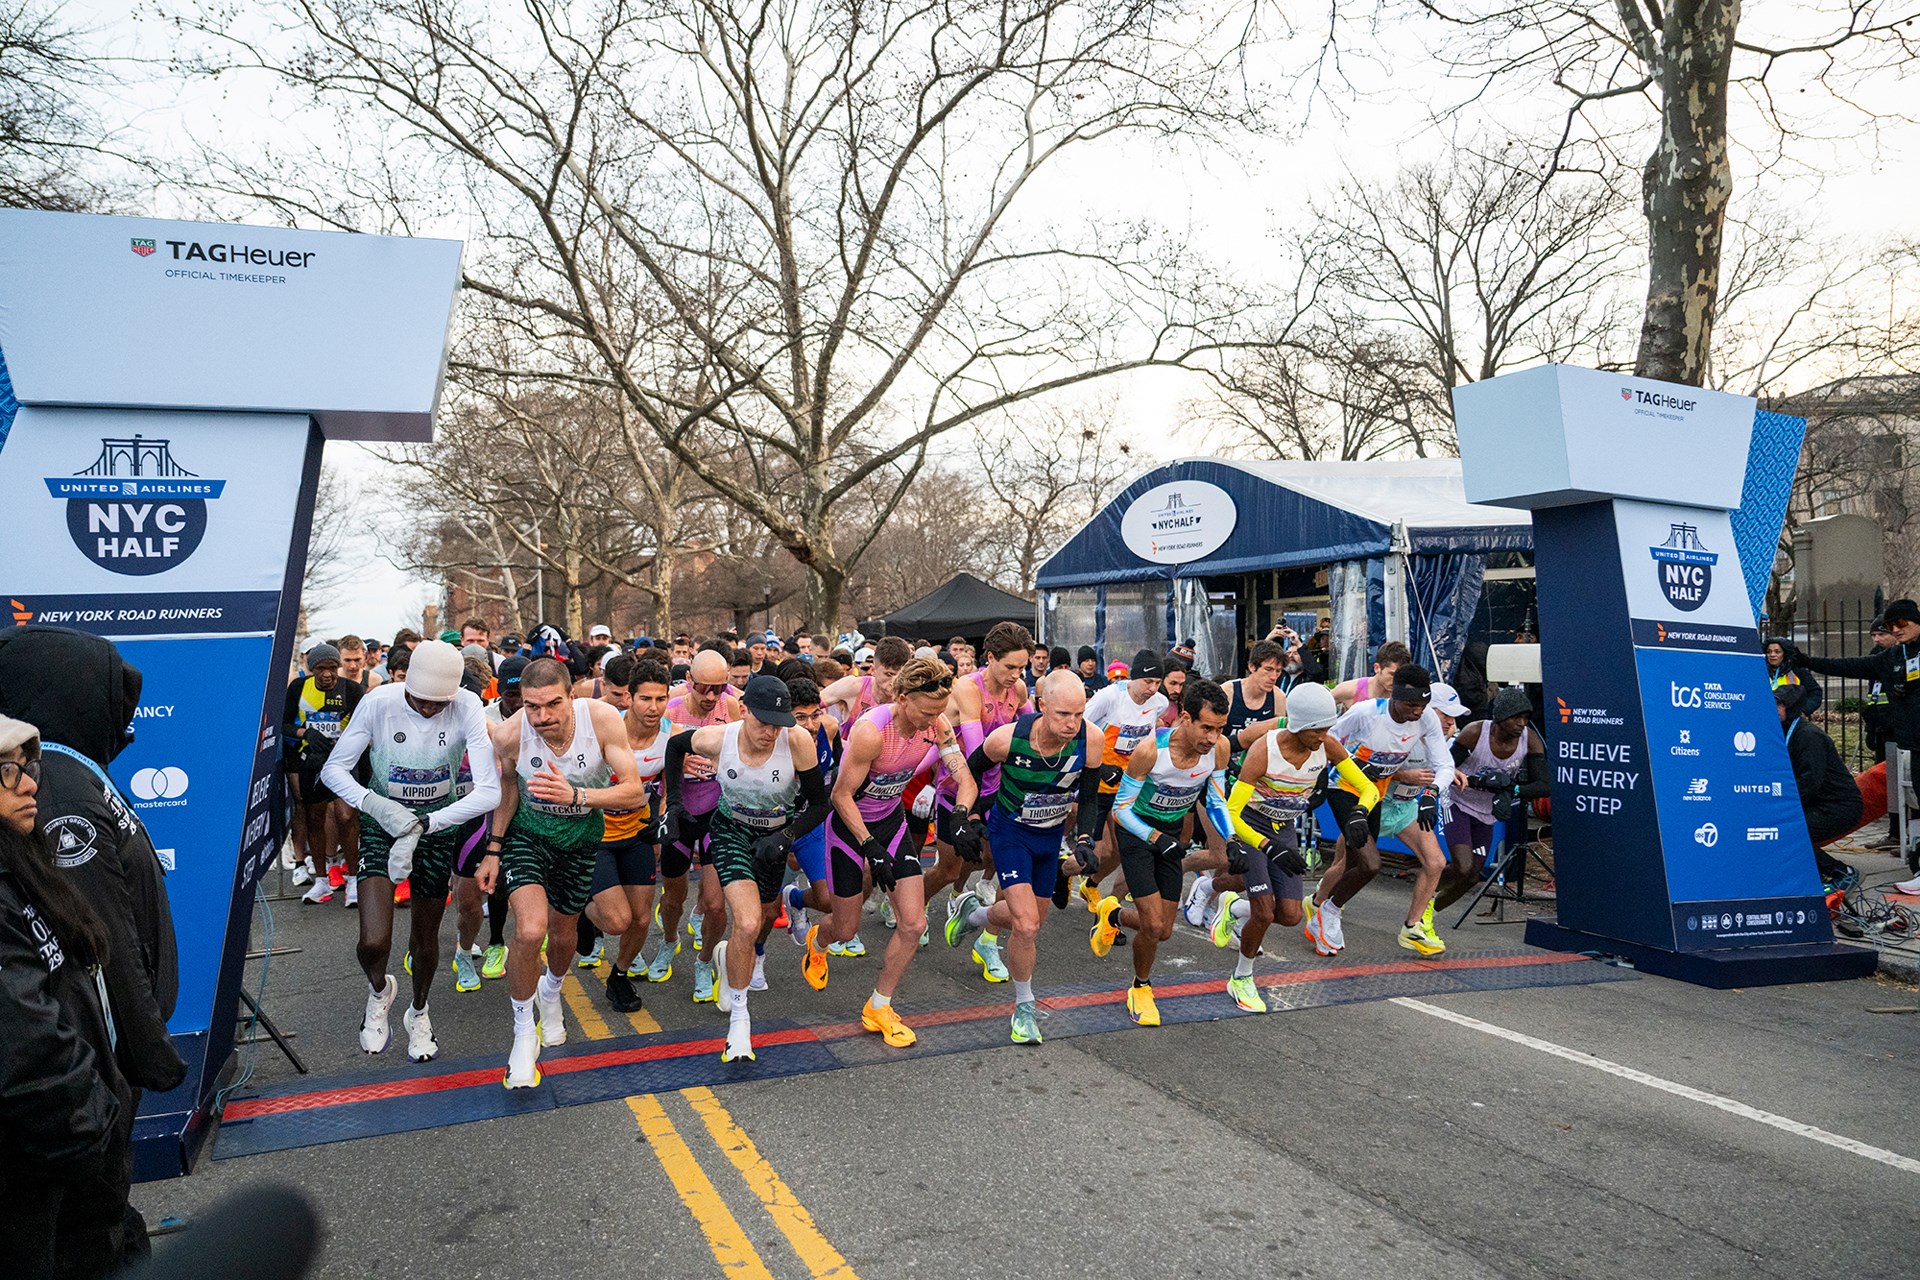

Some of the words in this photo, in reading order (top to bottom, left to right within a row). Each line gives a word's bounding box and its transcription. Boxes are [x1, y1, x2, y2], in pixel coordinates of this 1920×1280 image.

[165, 240, 316, 268] TAGHeuer
[165, 269, 216, 281] OFFICIAL
[219, 272, 286, 284] TIMEKEEPER
[1635, 390, 1697, 412] TAGHeuer
[60, 484, 119, 493] UNITED
[140, 484, 211, 493] AIRLINES
[88, 503, 187, 534] NYC
[97, 537, 180, 558] HALF
[1655, 551, 1678, 559] UNITED
[1685, 554, 1714, 562] AIRLINES
[1665, 564, 1704, 587] NYC
[1669, 586, 1702, 601] HALF
[38, 610, 75, 623] NEW
[75, 609, 115, 622] YORK
[117, 609, 157, 621] ROAD
[158, 607, 223, 620] RUNNERS
[1667, 631, 1681, 640] NEW
[1681, 632, 1697, 641] YORK
[1696, 633, 1712, 642] ROAD
[1712, 634, 1737, 644] RUNNERS
[1671, 680, 1702, 708] tcs
[1703, 682, 1723, 691] TATA
[1703, 691, 1746, 701] CONSULTANCY
[1703, 701, 1732, 710] SERVICES
[1572, 708, 1588, 716] NEW
[1588, 709, 1607, 717] YORK
[1573, 716, 1592, 724] ROAD
[1591, 717, 1624, 726] RUNNERS
[1559, 741, 1631, 763] BELIEVE
[1670, 745, 1700, 756] Citizens
[1557, 766, 1574, 784] IN
[1578, 768, 1640, 790] EVERY
[402, 786, 437, 798] KIPROP
[1733, 785, 1771, 793] UNITED
[133, 798, 187, 809] mastercard
[1155, 795, 1165, 805] EL
[1575, 795, 1622, 815] STEP
[541, 804, 582, 814] KLECKER
[1029, 806, 1067, 818] THOMSON
[748, 817, 770, 826] FORD
[1250, 883, 1269, 893] HOKA
